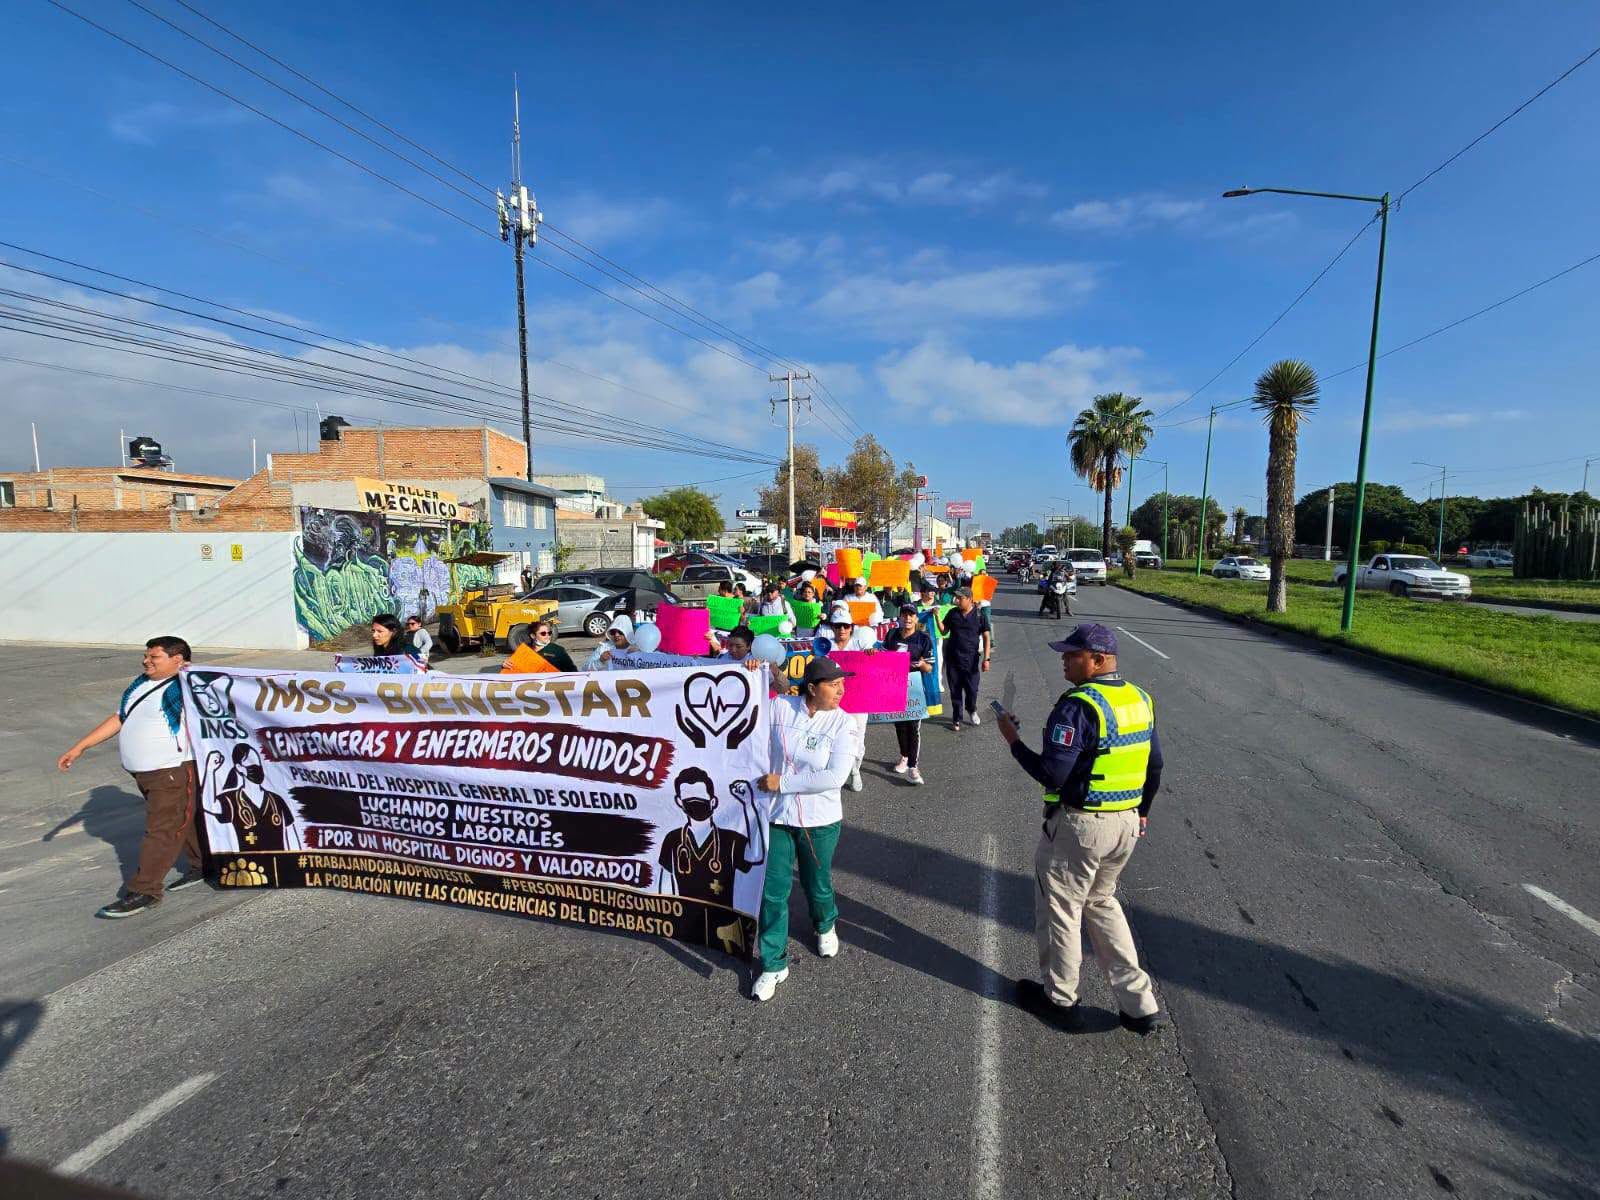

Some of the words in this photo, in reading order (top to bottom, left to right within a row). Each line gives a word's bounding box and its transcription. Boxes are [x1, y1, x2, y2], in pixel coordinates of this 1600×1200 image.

[365, 492, 457, 517] MECANICO
[386, 484, 439, 499] TALLER
[357, 657, 393, 670] SOMOS
[611, 656, 635, 668] Hospital
[255, 677, 370, 713] IMSS-
[377, 679, 652, 719] BIENESTAR
[200, 718, 249, 740] IMSS
[266, 727, 389, 758] ¡ENFERMERAS
[393, 730, 411, 758] Y
[412, 730, 555, 763] ENFERMEROS
[559, 735, 662, 781] UNIDOS!
[291, 766, 355, 788] PERSONAL
[359, 774, 381, 791] DEL
[385, 777, 457, 797] HOSPITAL
[459, 783, 531, 804] GENERAL
[534, 790, 556, 806] DE
[558, 791, 637, 810] SOLEDAD
[359, 795, 449, 818] LUCHANDO
[455, 803, 552, 828] NUESTROS
[362, 814, 445, 836] DERECHOS
[452, 822, 564, 848] LABORALES
[318, 829, 353, 847] ¡POR
[358, 834, 378, 849] UN
[385, 837, 450, 861] HOSPITAL
[456, 848, 516, 869] DIGNOS
[520, 853, 534, 867] Y
[539, 856, 641, 882] VALORADO!
[298, 855, 473, 885] #TRABAJANDOBAJOPROTESTA
[502, 879, 683, 917] #PERSONALDELHGSUNIDO
[305, 872, 322, 888] LA
[325, 875, 391, 895] POBLACIÓN
[394, 880, 421, 898] VIVE
[424, 885, 447, 901] LAS
[450, 887, 557, 918] CONSECUENCIAS
[560, 903, 586, 923] DEL
[589, 908, 674, 938] DESABASTO
